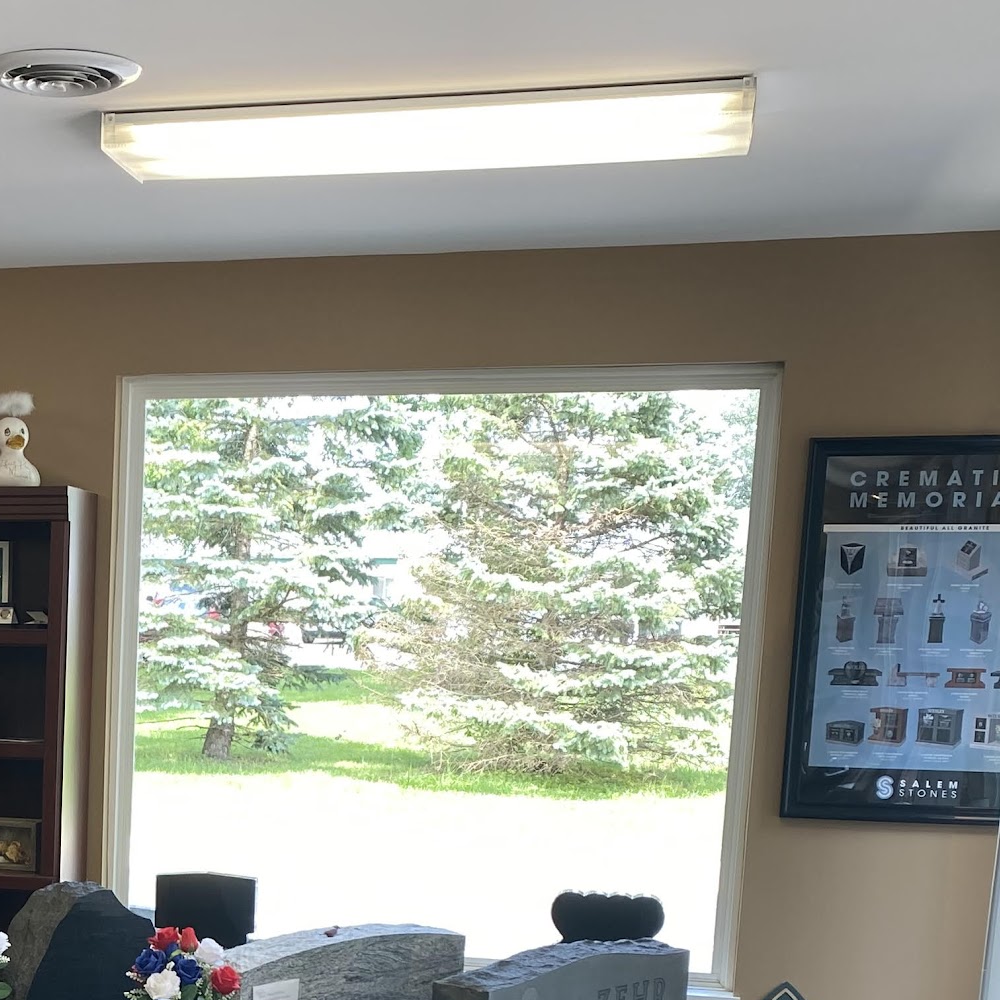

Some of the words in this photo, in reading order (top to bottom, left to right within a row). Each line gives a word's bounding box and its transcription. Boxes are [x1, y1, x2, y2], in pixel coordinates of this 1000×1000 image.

[850, 469, 999, 487] CREMATI
[899, 779, 959, 789] SALEM
[898, 789, 957, 799] STONES
